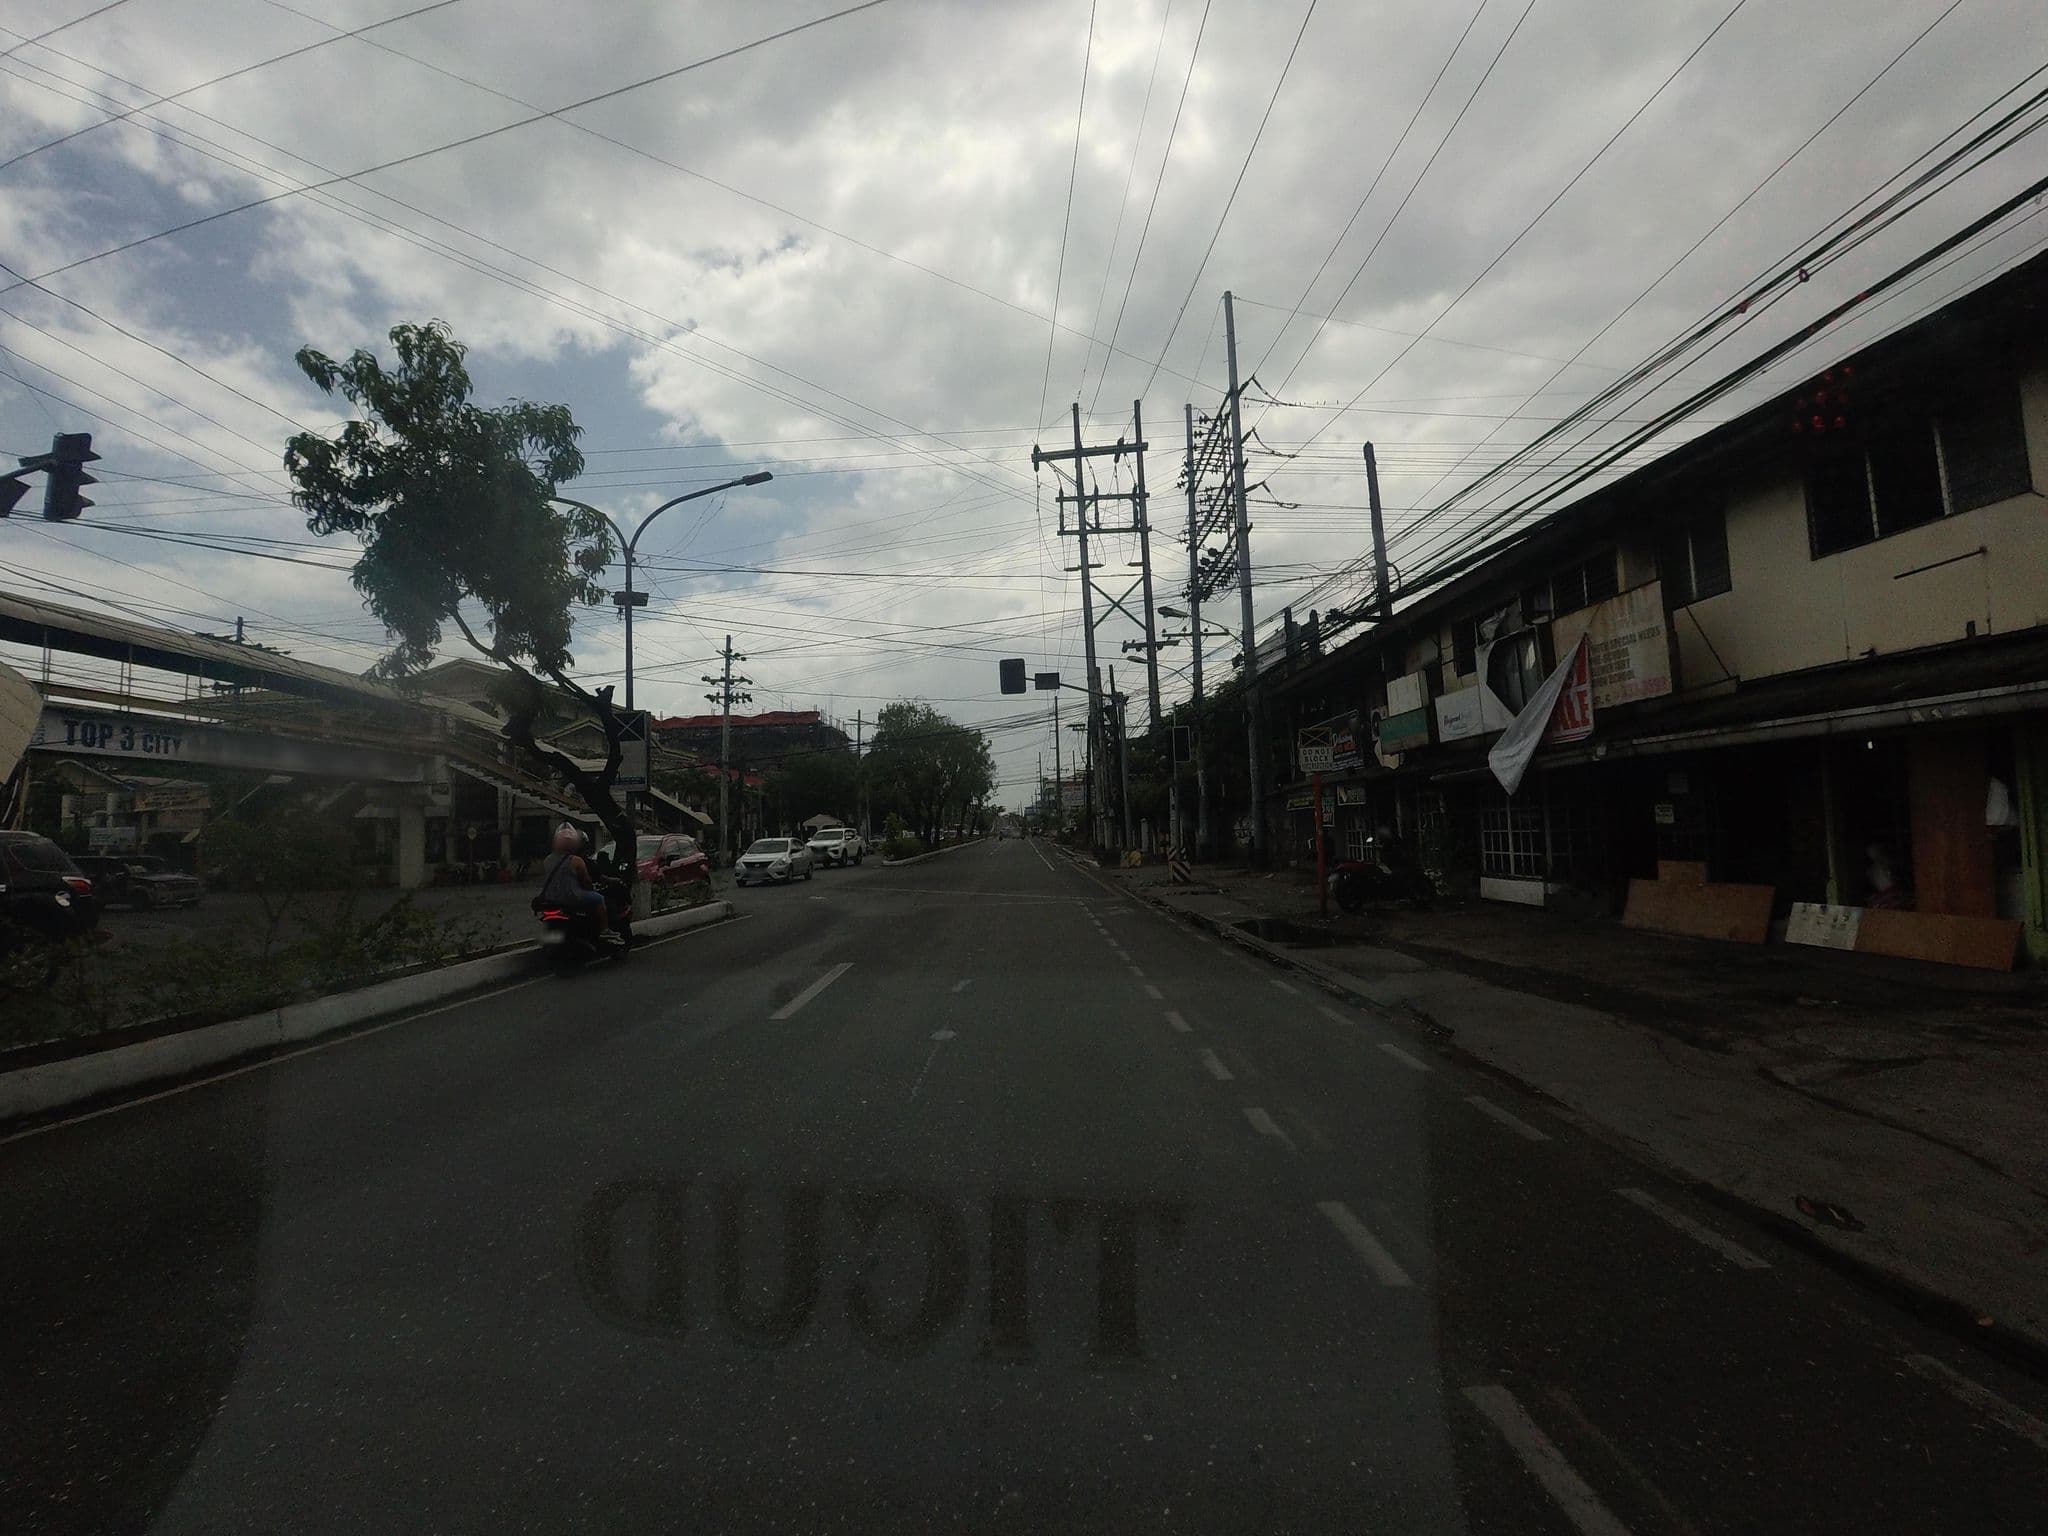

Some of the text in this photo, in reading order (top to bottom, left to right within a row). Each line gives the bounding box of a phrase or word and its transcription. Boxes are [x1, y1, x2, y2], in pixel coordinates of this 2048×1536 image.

[64, 719, 113, 750] TOP
[120, 725, 135, 751] 3
[142, 732, 182, 754] CITY
[1302, 748, 1312, 756] DO
[1314, 748, 1329, 756] NOT
